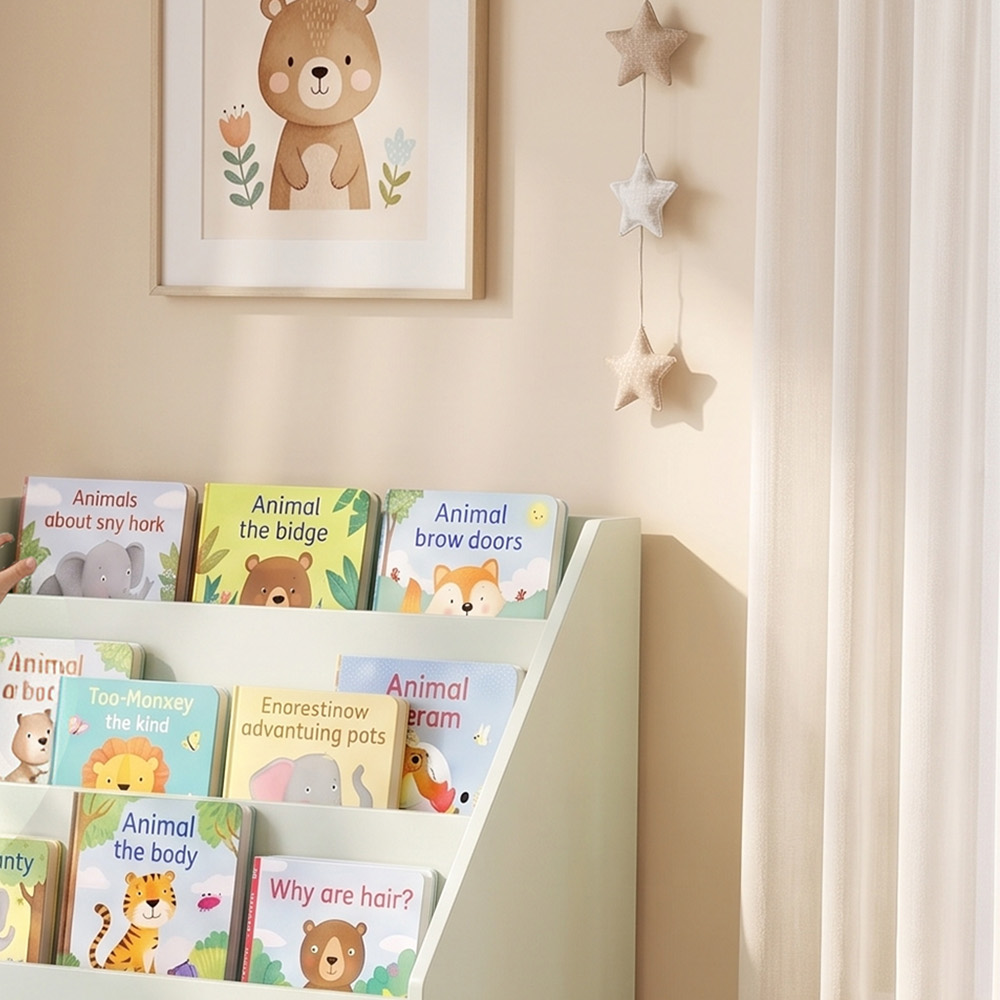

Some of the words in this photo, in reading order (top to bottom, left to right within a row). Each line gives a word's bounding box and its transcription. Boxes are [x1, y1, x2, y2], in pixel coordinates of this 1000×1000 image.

[72, 489, 138, 508] Animals
[251, 495, 320, 516] Animal
[45, 511, 92, 530] about
[96, 516, 125, 535] sny
[129, 515, 165, 532] hork
[434, 503, 507, 524] Animal
[239, 519, 270, 539] the
[276, 521, 328, 546] bidge
[415, 528, 464, 548] brow
[468, 530, 523, 550] doors
[386, 673, 469, 701] Animal
[89, 686, 194, 716] Too-Monxey
[105, 714, 131, 730] the
[136, 714, 170, 733] kind
[241, 719, 342, 747] advantuing
[347, 728, 386, 748] pots
[122, 812, 195, 838] Animal
[114, 839, 145, 861] the
[151, 842, 198, 871] body
[270, 878, 315, 907] Why
[321, 888, 354, 905] are
[360, 885, 414, 910] hair?
